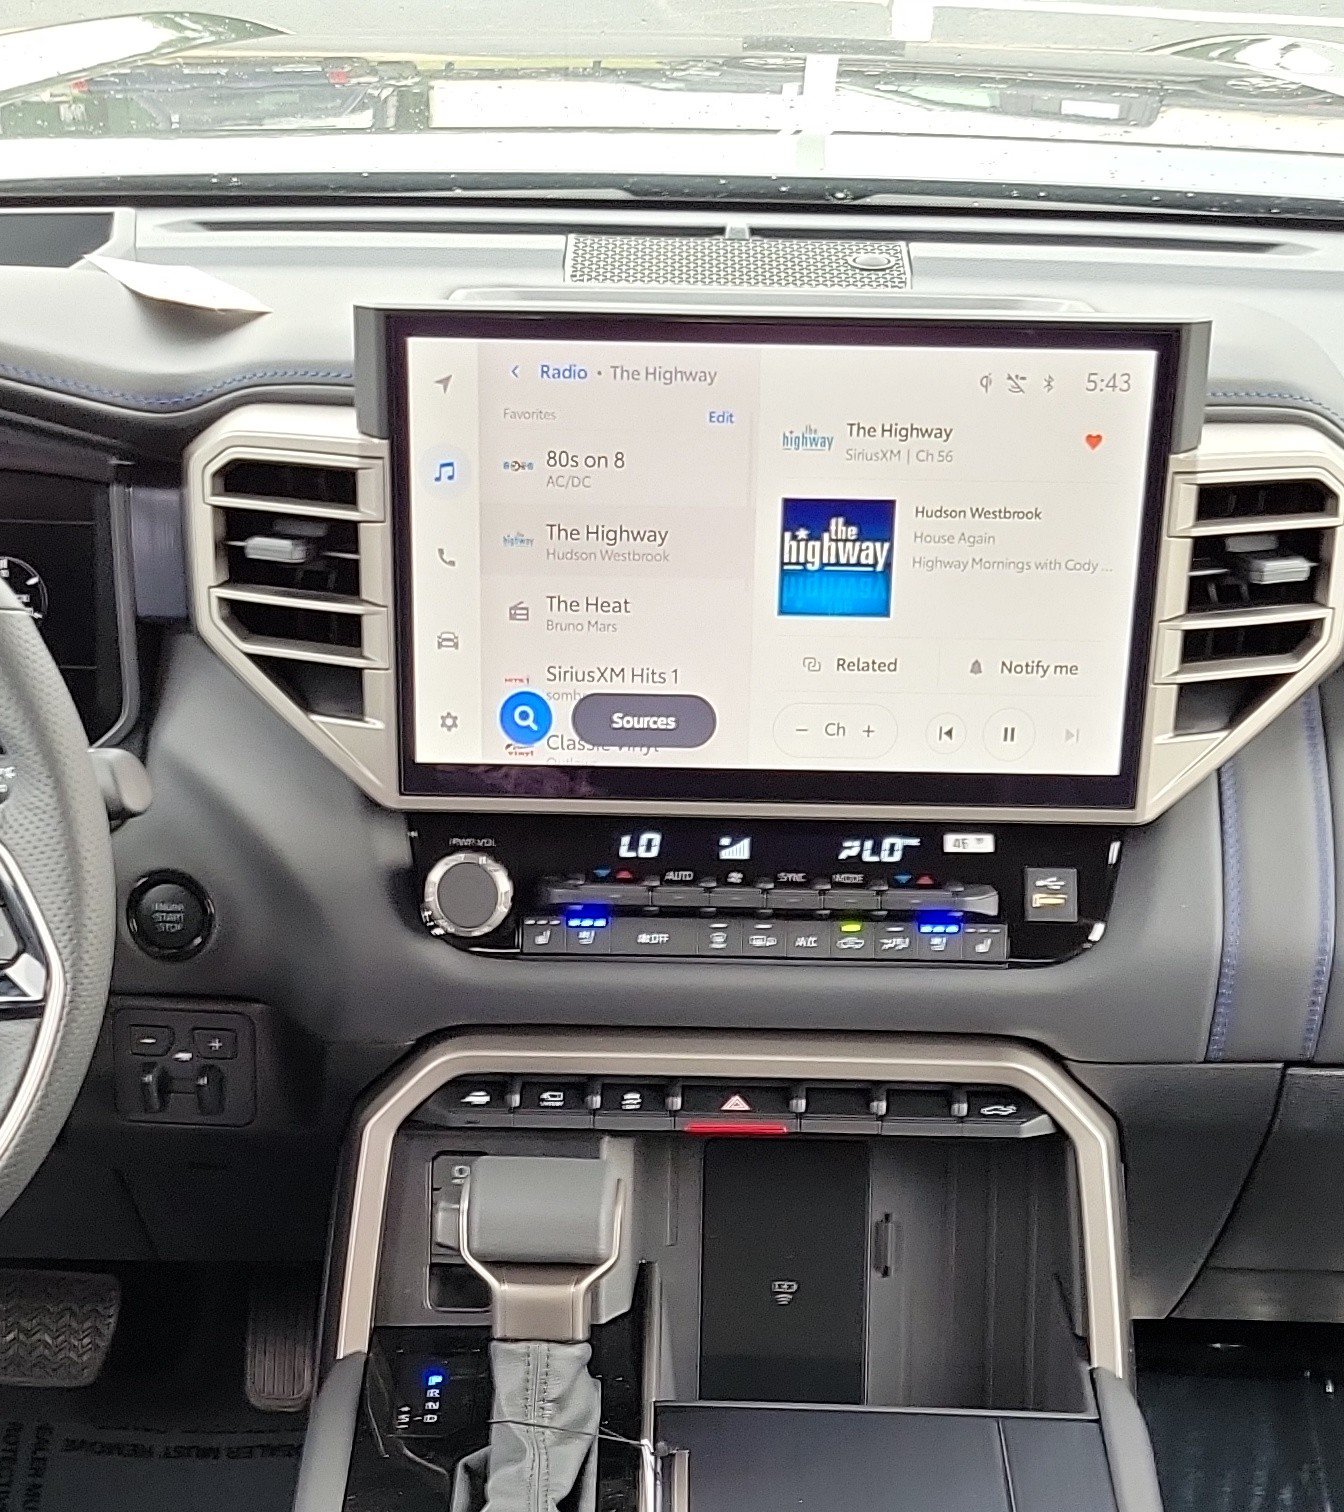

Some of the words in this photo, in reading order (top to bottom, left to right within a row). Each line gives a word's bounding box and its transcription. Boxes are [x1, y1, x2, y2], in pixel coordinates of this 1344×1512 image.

[540, 364, 588, 380] Radio
[610, 366, 641, 381] The
[645, 366, 717, 386] Highway
[1085, 372, 1131, 393] 5:43
[503, 408, 556, 421] Favorites
[708, 410, 735, 424] Edit
[782, 430, 834, 450] highway
[846, 422, 877, 438] The
[881, 423, 953, 442] Highway
[546, 450, 579, 468] 80s
[584, 454, 608, 468] on
[613, 451, 626, 469] 8
[845, 448, 902, 462] SiriusXM
[916, 450, 934, 462] Ch
[937, 450, 954, 463] 56
[546, 476, 592, 489] AC/DC
[914, 506, 966, 519] Hudson
[970, 507, 1043, 520] Westbrook
[546, 523, 581, 541] The
[586, 525, 669, 547] Highway
[830, 517, 858, 540] the
[913, 532, 955, 545] House
[958, 533, 996, 547] Again
[546, 549, 597, 561] Hudson
[600, 549, 670, 562] Westbrook
[783, 530, 891, 571] highway
[912, 557, 969, 572] Highway
[971, 558, 1032, 573] Mornings
[1034, 559, 1062, 571] with
[1064, 559, 1099, 573] Cody
[546, 595, 580, 613] The
[585, 596, 631, 614] Heat
[546, 620, 584, 632] Bruno
[587, 620, 618, 633] Mars
[836, 657, 898, 673] Related
[1000, 660, 1050, 678] Notify
[1053, 664, 1079, 676] me
[546, 665, 626, 684] SiriusXM
[631, 667, 667, 684] Hits
[672, 668, 680, 685] 1
[611, 712, 677, 731] Sources
[824, 722, 846, 737] Ch
[618, 831, 662, 859] LO
[861, 837, 904, 863] LO
[664, 870, 694, 881] AUTO
[777, 871, 808, 883] SYNC
[832, 872, 865, 883] MODE
[427, 1374, 443, 1387] P
[426, 1388, 440, 1398] R
[422, 1413, 437, 1423] D
